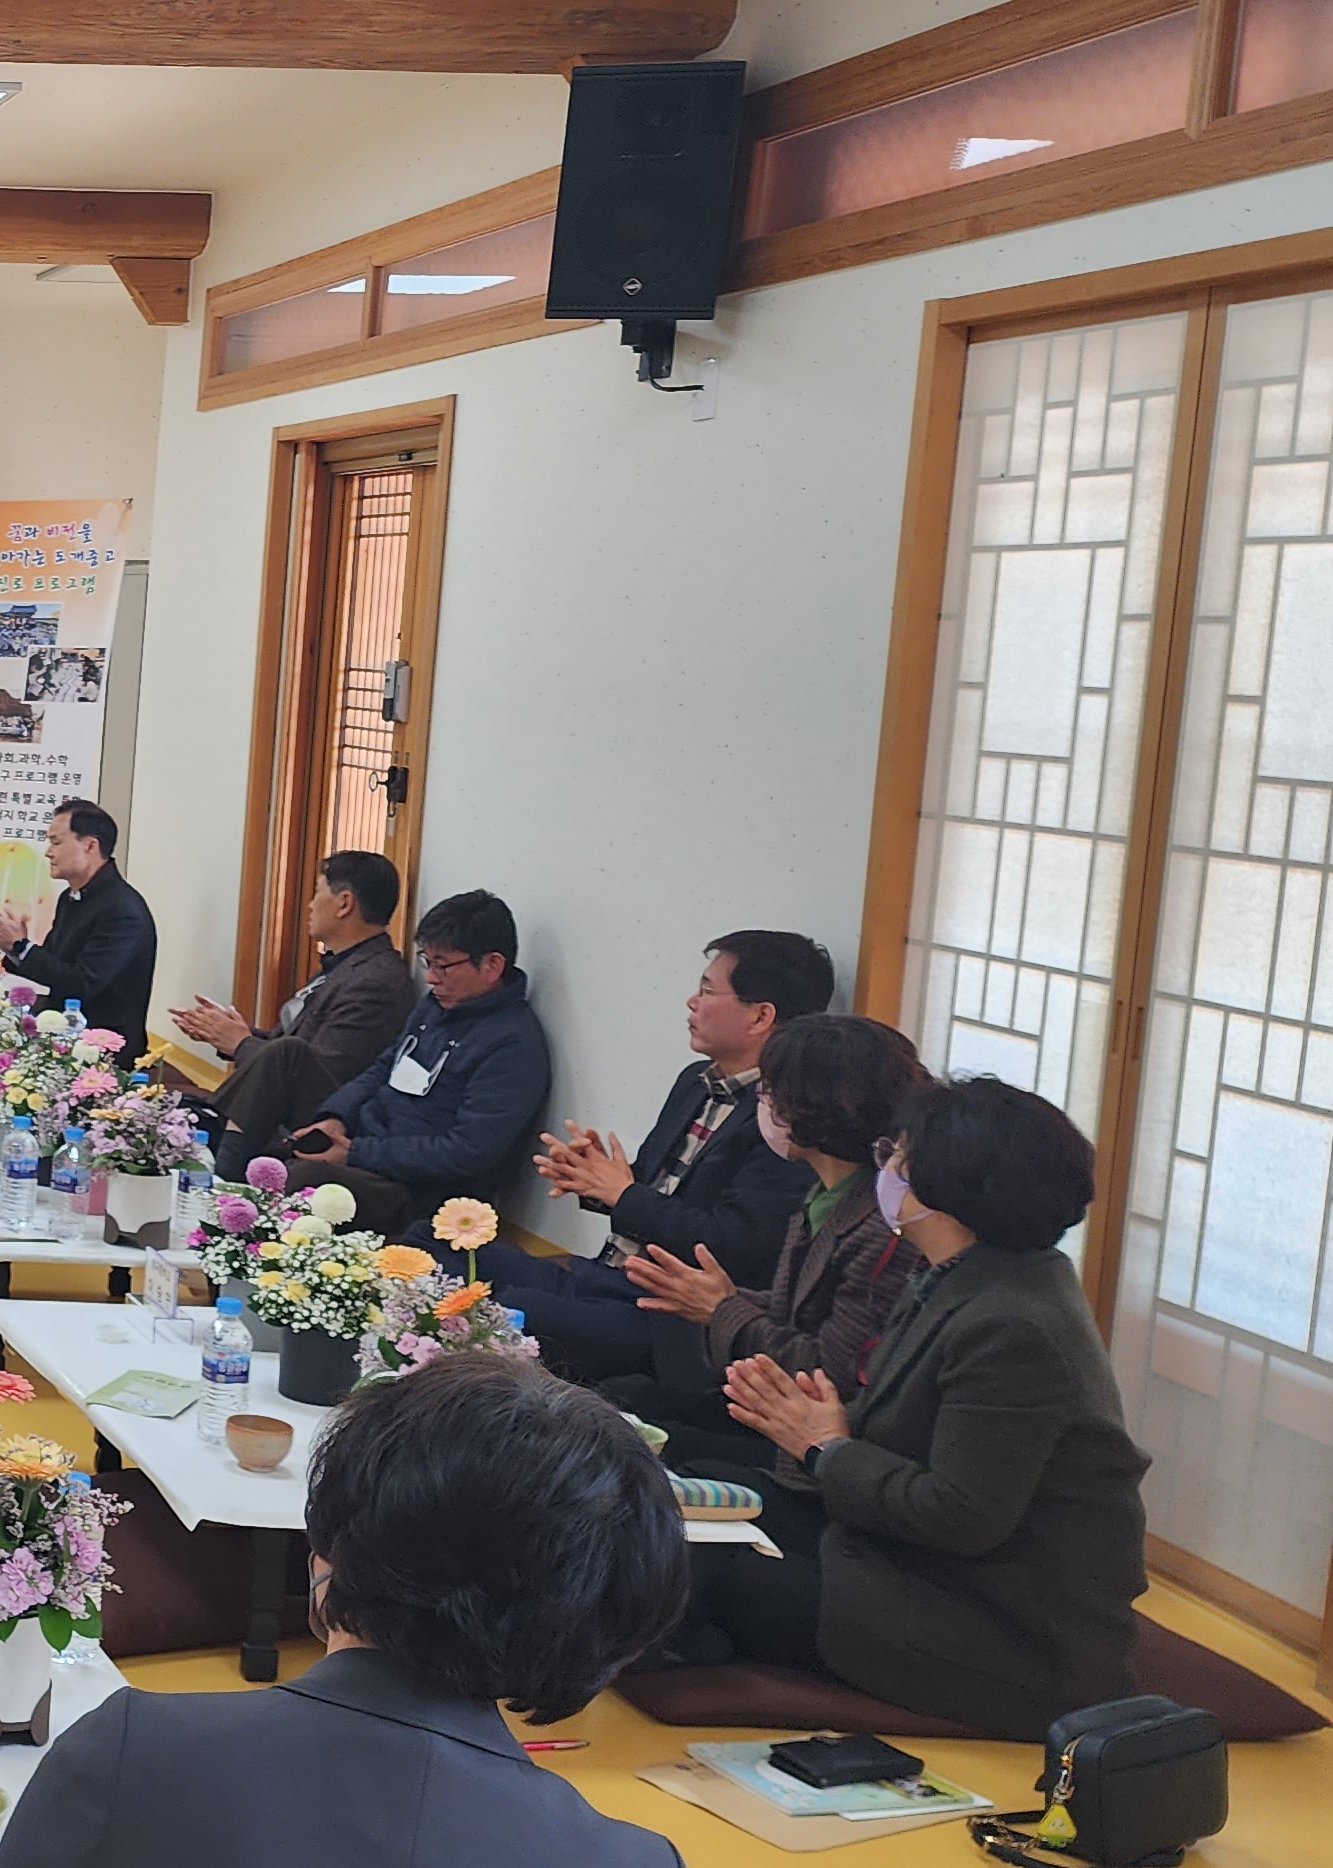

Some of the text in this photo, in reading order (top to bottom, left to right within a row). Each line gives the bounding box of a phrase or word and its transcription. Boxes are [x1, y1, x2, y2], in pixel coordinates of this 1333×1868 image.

[7, 522, 92, 543] 꿈과 비전을
[34, 575, 95, 594] 프로그램
[13, 770, 58, 785] 프로그램
[17, 810, 39, 822] 학교
